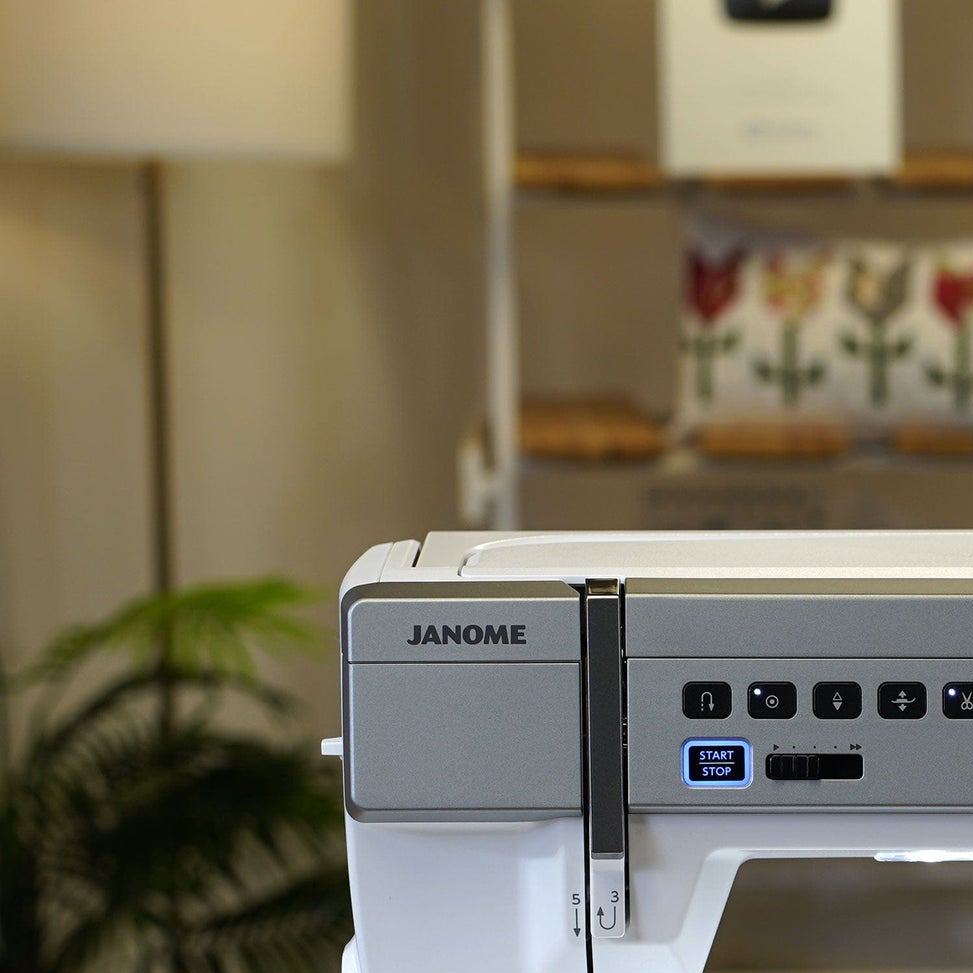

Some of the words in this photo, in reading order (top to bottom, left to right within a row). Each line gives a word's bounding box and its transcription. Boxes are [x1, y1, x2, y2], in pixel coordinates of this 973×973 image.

[406, 624, 527, 646] JANOME
[699, 751, 734, 761] START
[702, 766, 732, 776] STOP
[572, 894, 581, 905] 5
[610, 891, 619, 903] 3
